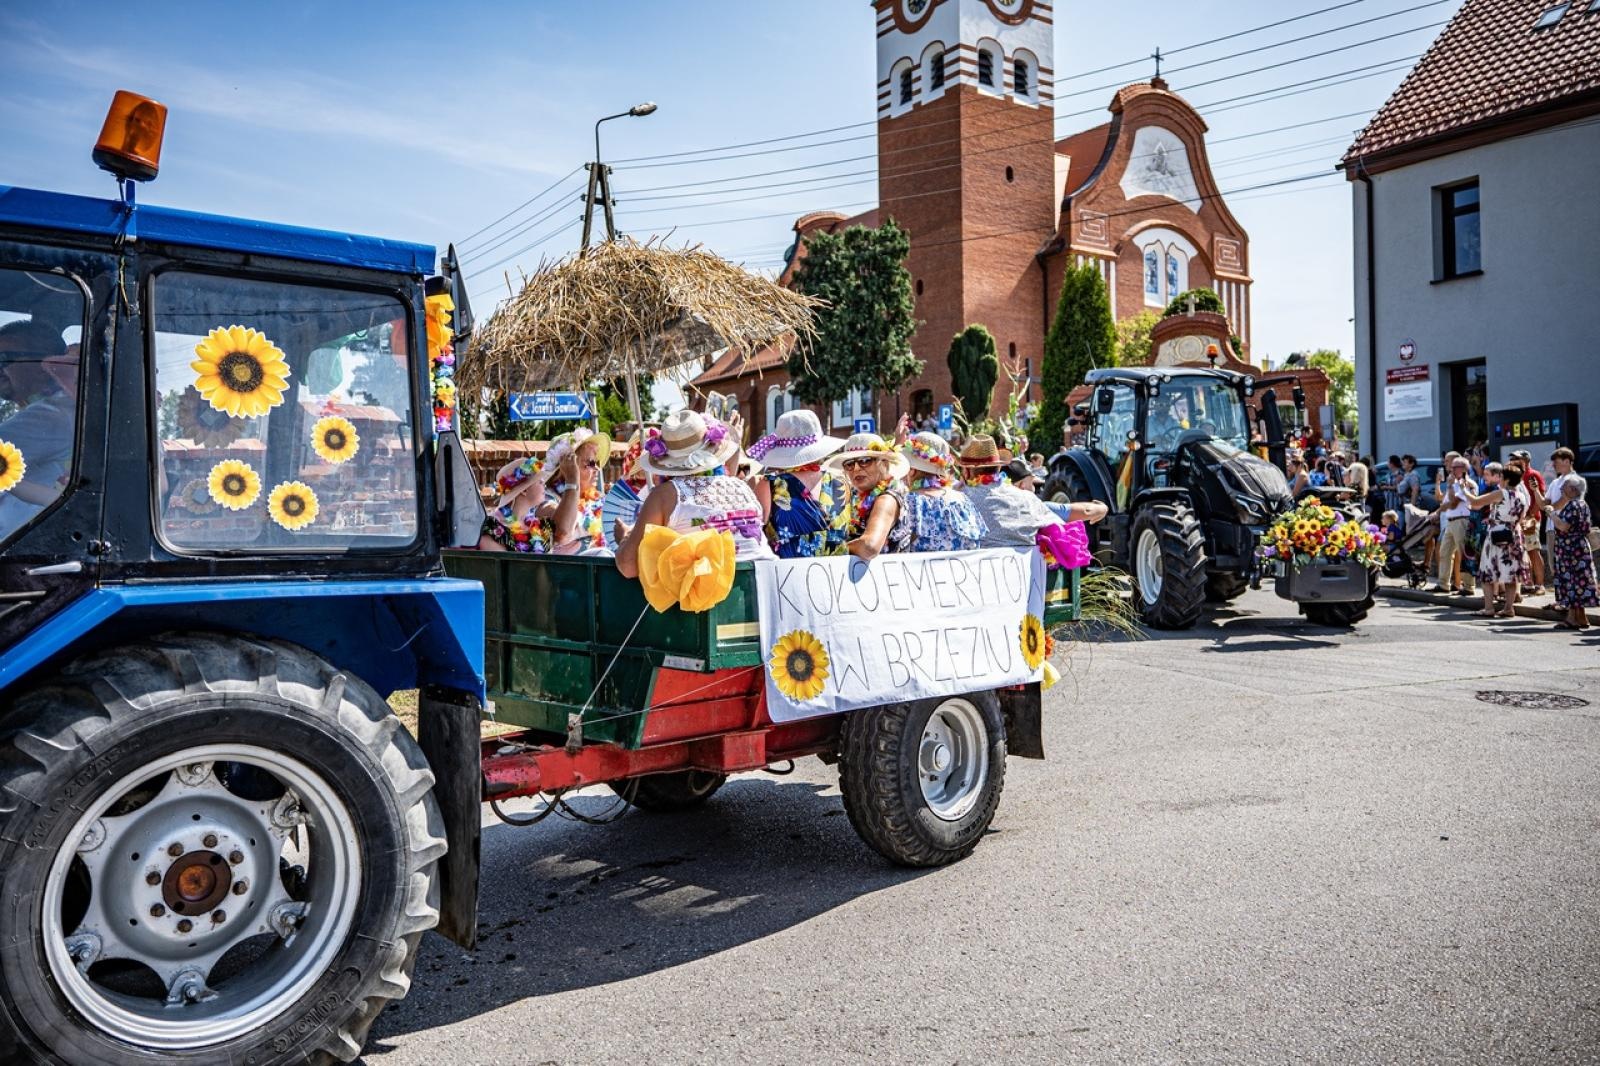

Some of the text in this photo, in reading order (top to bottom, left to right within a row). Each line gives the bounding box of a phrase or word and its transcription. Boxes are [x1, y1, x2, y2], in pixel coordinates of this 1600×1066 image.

[942, 407, 951, 422] P
[826, 624, 1012, 693] W BRZEZIU
